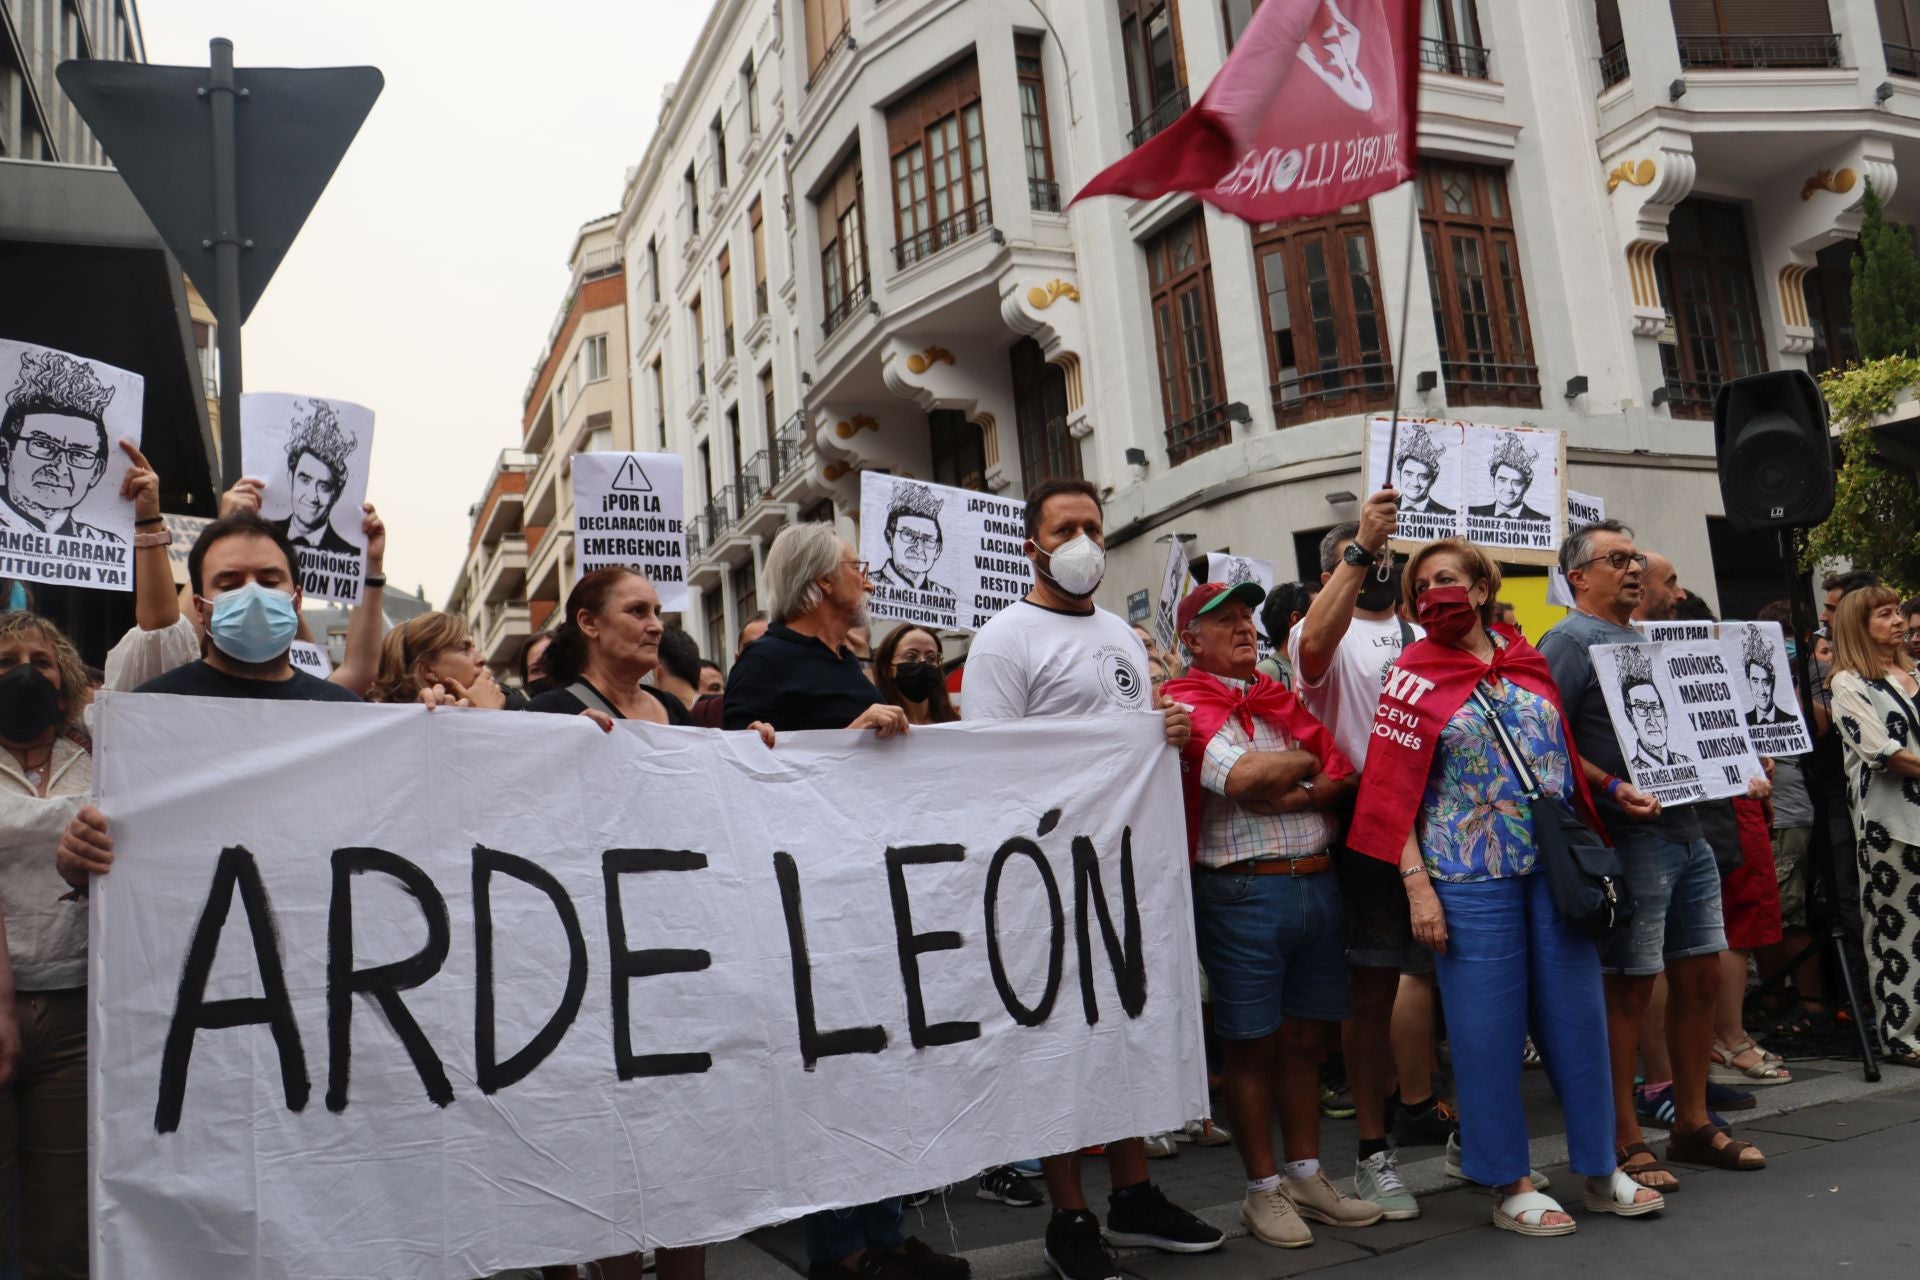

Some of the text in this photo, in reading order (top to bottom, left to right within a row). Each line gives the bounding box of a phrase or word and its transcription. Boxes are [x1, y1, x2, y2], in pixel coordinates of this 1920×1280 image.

[603, 493, 661, 513] ¡POR LA
[967, 498, 1010, 518] ¡APOYO
[579, 516, 682, 533] DECLARACIÓN DE
[983, 519, 1026, 540] OMAÑA
[583, 538, 681, 558] EMERGENCIA
[980, 537, 1026, 558] LACIAN
[1466, 529, 1551, 547] ¡DIMISIÓN YA!
[57, 539, 126, 564] ARRANZ
[644, 564, 683, 582] PARA
[974, 555, 1031, 578] VALDERÍA
[96, 568, 127, 586] YA!
[980, 575, 1019, 595] RESTO
[334, 577, 359, 600] YA!
[920, 592, 957, 611] ARRANZ
[941, 614, 957, 628] YA!
[1651, 626, 1709, 642] ¡APOYO PARA
[291, 649, 321, 667] PARA
[1667, 653, 1728, 679] ¡QUIÑONES,
[1678, 680, 1731, 704] MAÑUECO
[1688, 709, 1740, 732] Y ARRANZ
[1697, 733, 1749, 760] DIMISIÓN
[1787, 736, 1808, 751] YA!
[1671, 765, 1699, 782] ARRANZ
[1722, 764, 1742, 785] YA!
[154, 807, 1146, 1134] ARDE LEÓN
